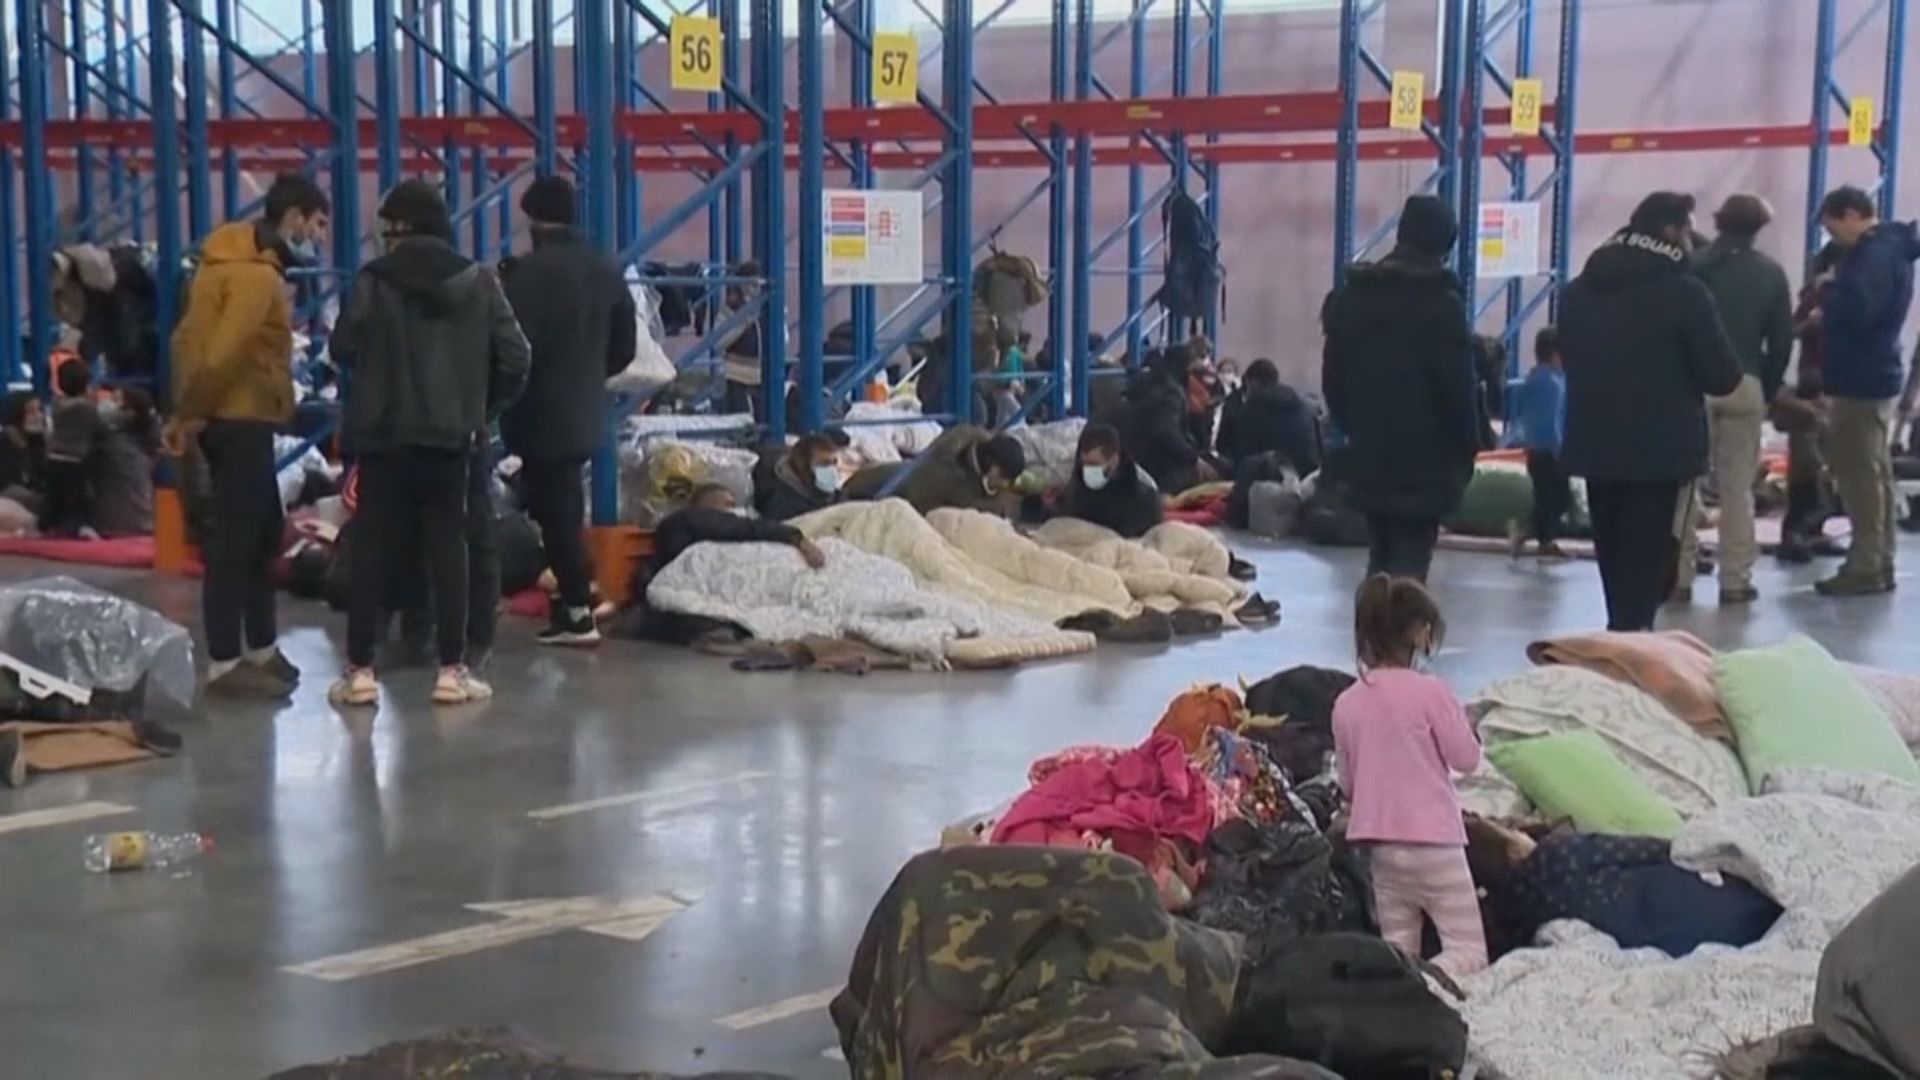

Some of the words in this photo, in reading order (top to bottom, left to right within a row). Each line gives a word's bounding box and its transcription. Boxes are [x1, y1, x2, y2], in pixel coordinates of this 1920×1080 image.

[681, 34, 712, 73] 56
[881, 50, 908, 86] 57
[1397, 86, 1417, 115] 58
[1627, 232, 1683, 262] SQUAD
